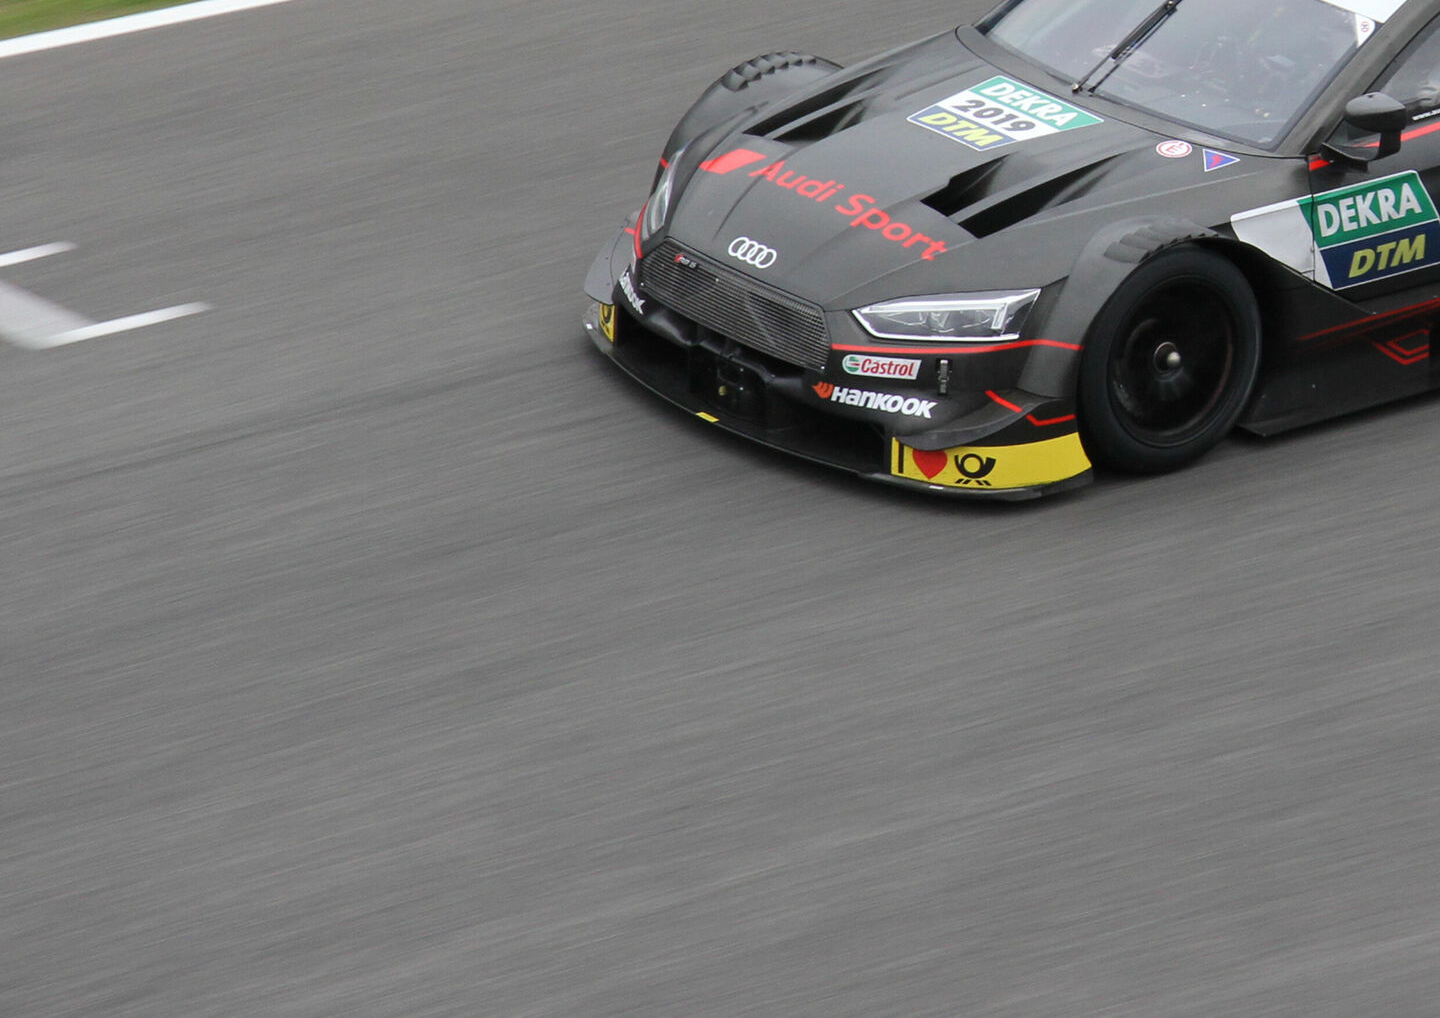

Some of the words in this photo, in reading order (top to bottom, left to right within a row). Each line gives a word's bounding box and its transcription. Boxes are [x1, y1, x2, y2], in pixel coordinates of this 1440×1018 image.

[952, 99, 1036, 132] 2019
[980, 82, 1079, 127] DEKRA
[918, 112, 1004, 147] DTM
[748, 160, 845, 203] Audi
[835, 193, 947, 261] Sport
[1317, 181, 1423, 237] DEKRA
[1348, 234, 1426, 279] DTM
[861, 357, 917, 377] Castrol
